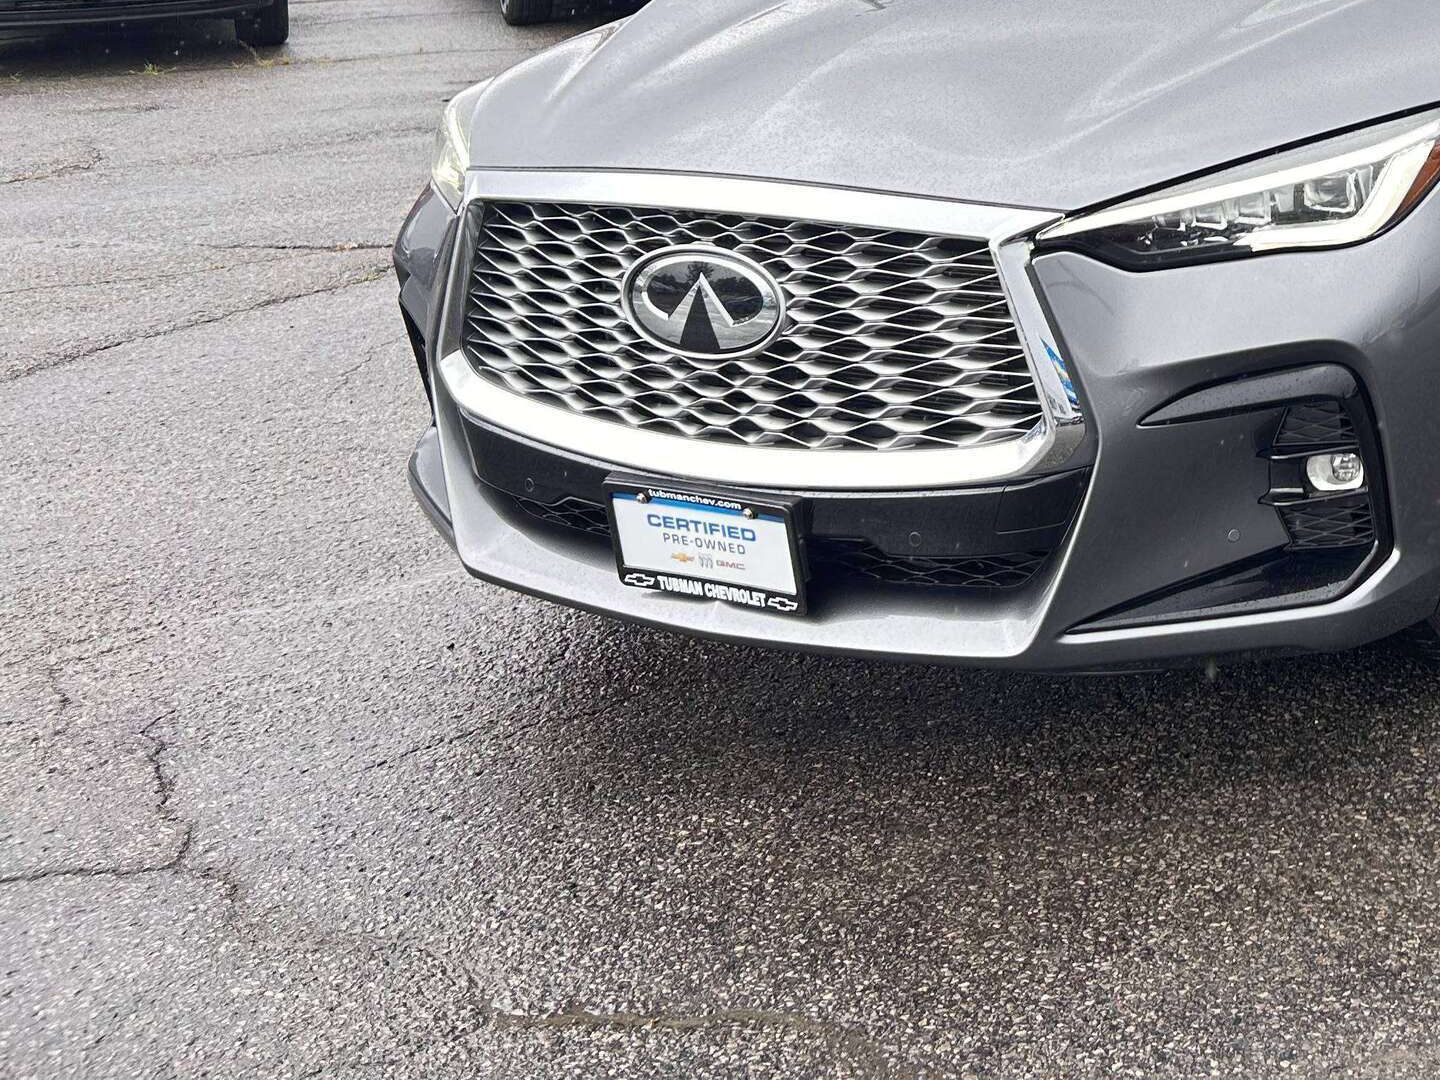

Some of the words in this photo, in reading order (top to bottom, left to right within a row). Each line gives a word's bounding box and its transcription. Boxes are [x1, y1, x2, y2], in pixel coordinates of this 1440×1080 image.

[648, 488, 742, 511] tubmanchev.com
[647, 514, 756, 542] CERTIFIED
[663, 533, 746, 555] PRE-OWNED
[716, 560, 746, 570] GMC
[657, 575, 704, 597] TUBMAN
[704, 583, 766, 608] CHEVROLET
